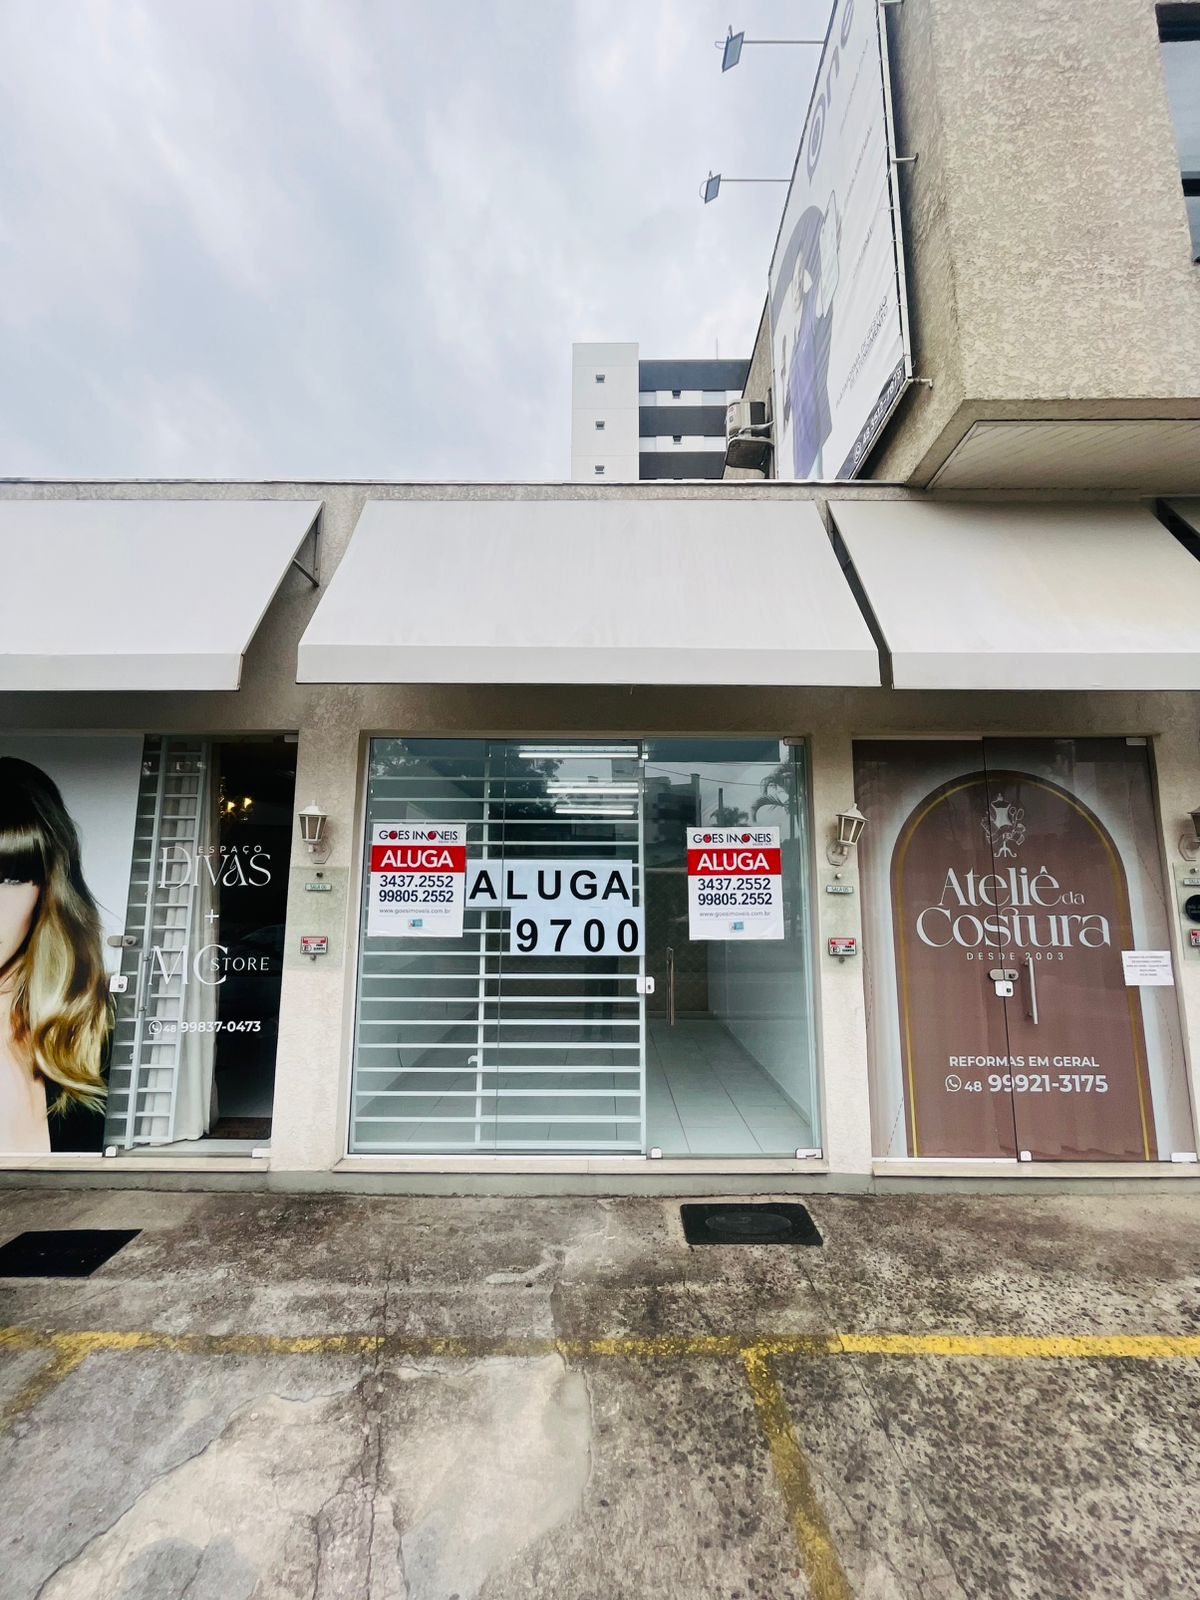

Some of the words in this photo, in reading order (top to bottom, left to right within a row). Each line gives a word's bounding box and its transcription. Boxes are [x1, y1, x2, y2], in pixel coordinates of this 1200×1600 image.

[199, 845, 262, 855] ESPAÇO
[380, 849, 454, 869] ALUGA
[697, 852, 770, 872] ALUGA
[379, 874, 454, 888] 3437.2552
[468, 869, 631, 901] ALUGA
[697, 877, 771, 891] 3437.2552
[938, 865, 1062, 907] Ateliê
[1061, 890, 1085, 905] da
[378, 889, 454, 903] 99805.2552
[698, 892, 773, 906] 99805.2552
[916, 906, 1112, 948] Costura
[516, 918, 640, 953] 9700
[966, 952, 1016, 961] DESDE
[1025, 951, 1065, 961] 2003
[210, 956, 270, 972] STORE
[162, 1024, 177, 1033] 48
[180, 1020, 262, 1033] 99837-0473
[949, 1055, 1026, 1068] REFORMAS
[1029, 1055, 1050, 1067] EM
[1053, 1055, 1101, 1068] GERAL
[963, 1080, 983, 1093] 48
[987, 1073, 1109, 1093] 99921-3175
